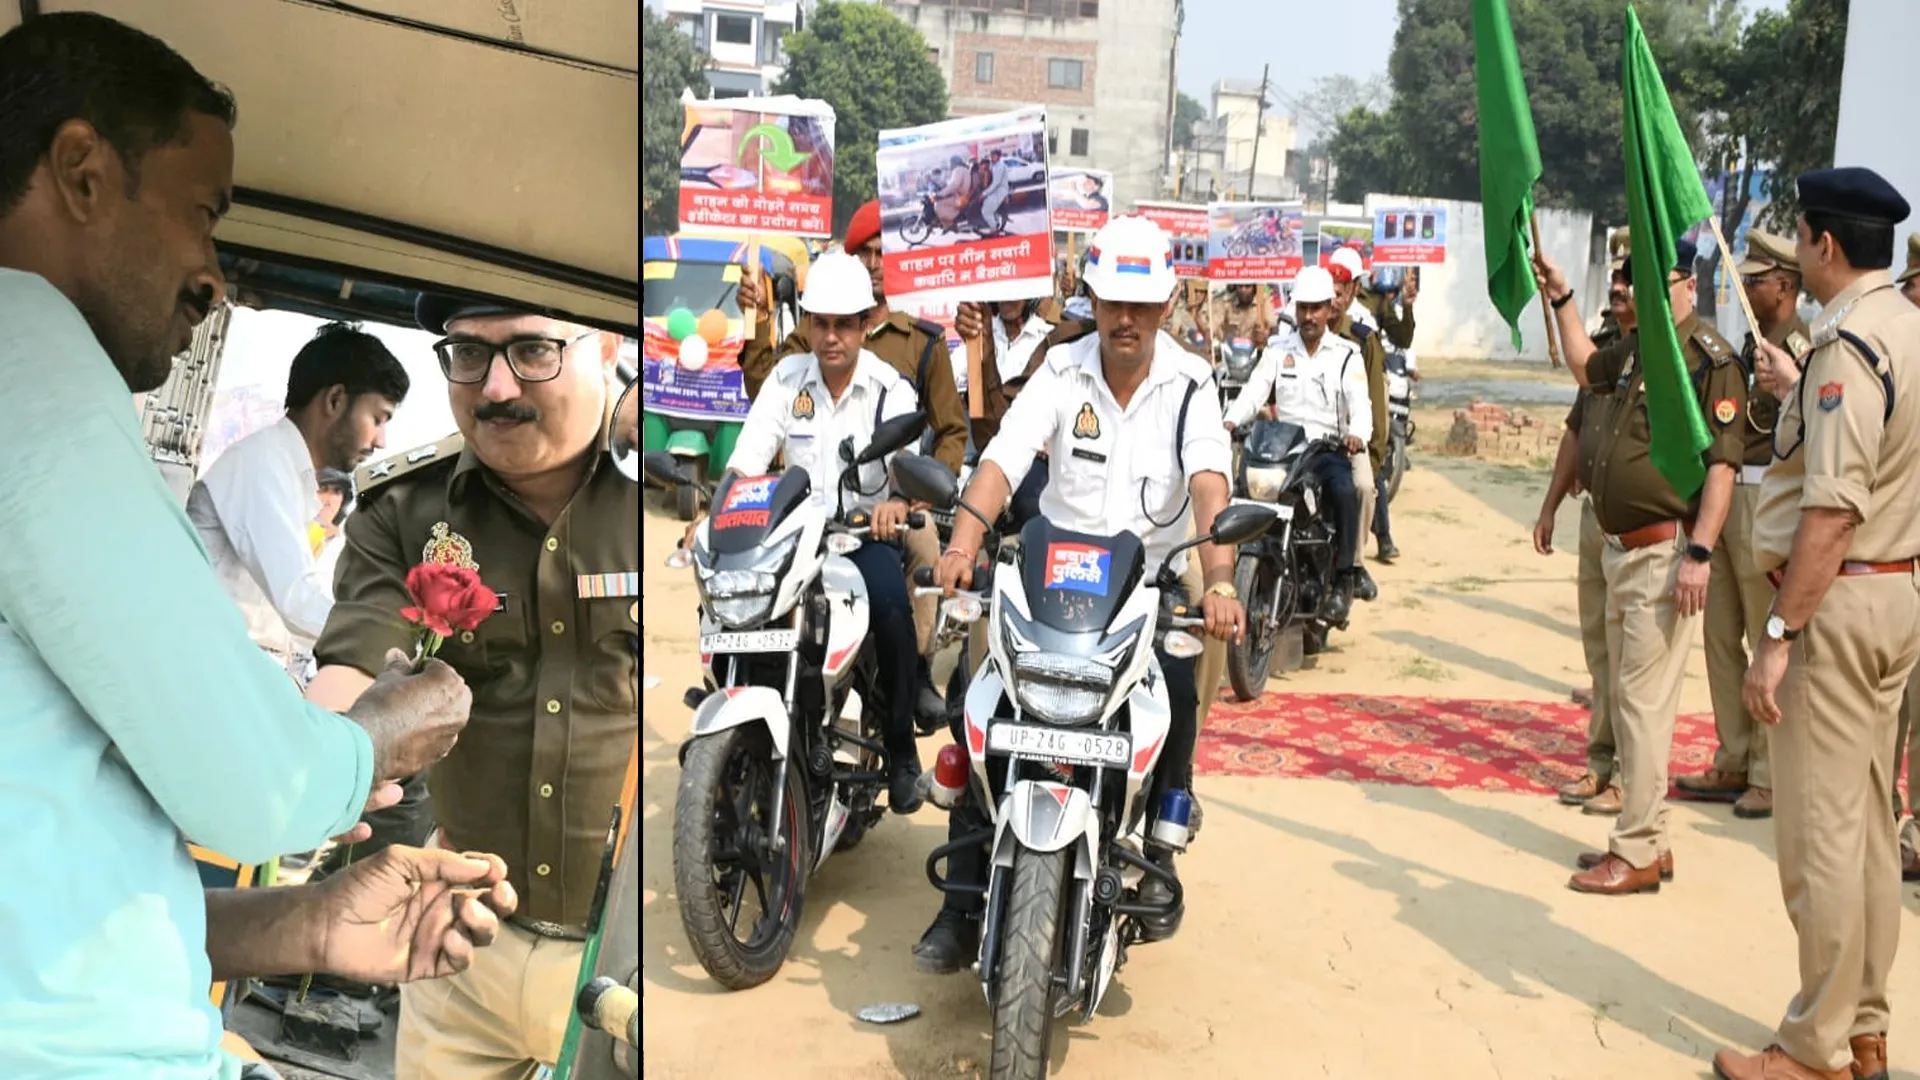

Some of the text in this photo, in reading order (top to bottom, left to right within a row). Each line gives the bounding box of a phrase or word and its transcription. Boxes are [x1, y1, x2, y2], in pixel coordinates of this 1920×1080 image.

[693, 194, 728, 207] वाहन
[732, 194, 749, 209] को
[788, 202, 821, 214] समय
[740, 213, 757, 225] का
[761, 214, 797, 229] प्रयोग
[899, 241, 1030, 272] वाहन पर तीन सवारी
[914, 270, 955, 287] कदापि
[960, 271, 971, 282] न
[1052, 564, 1102, 584] पुलिस
[1010, 732, 1066, 751] UP-24G
